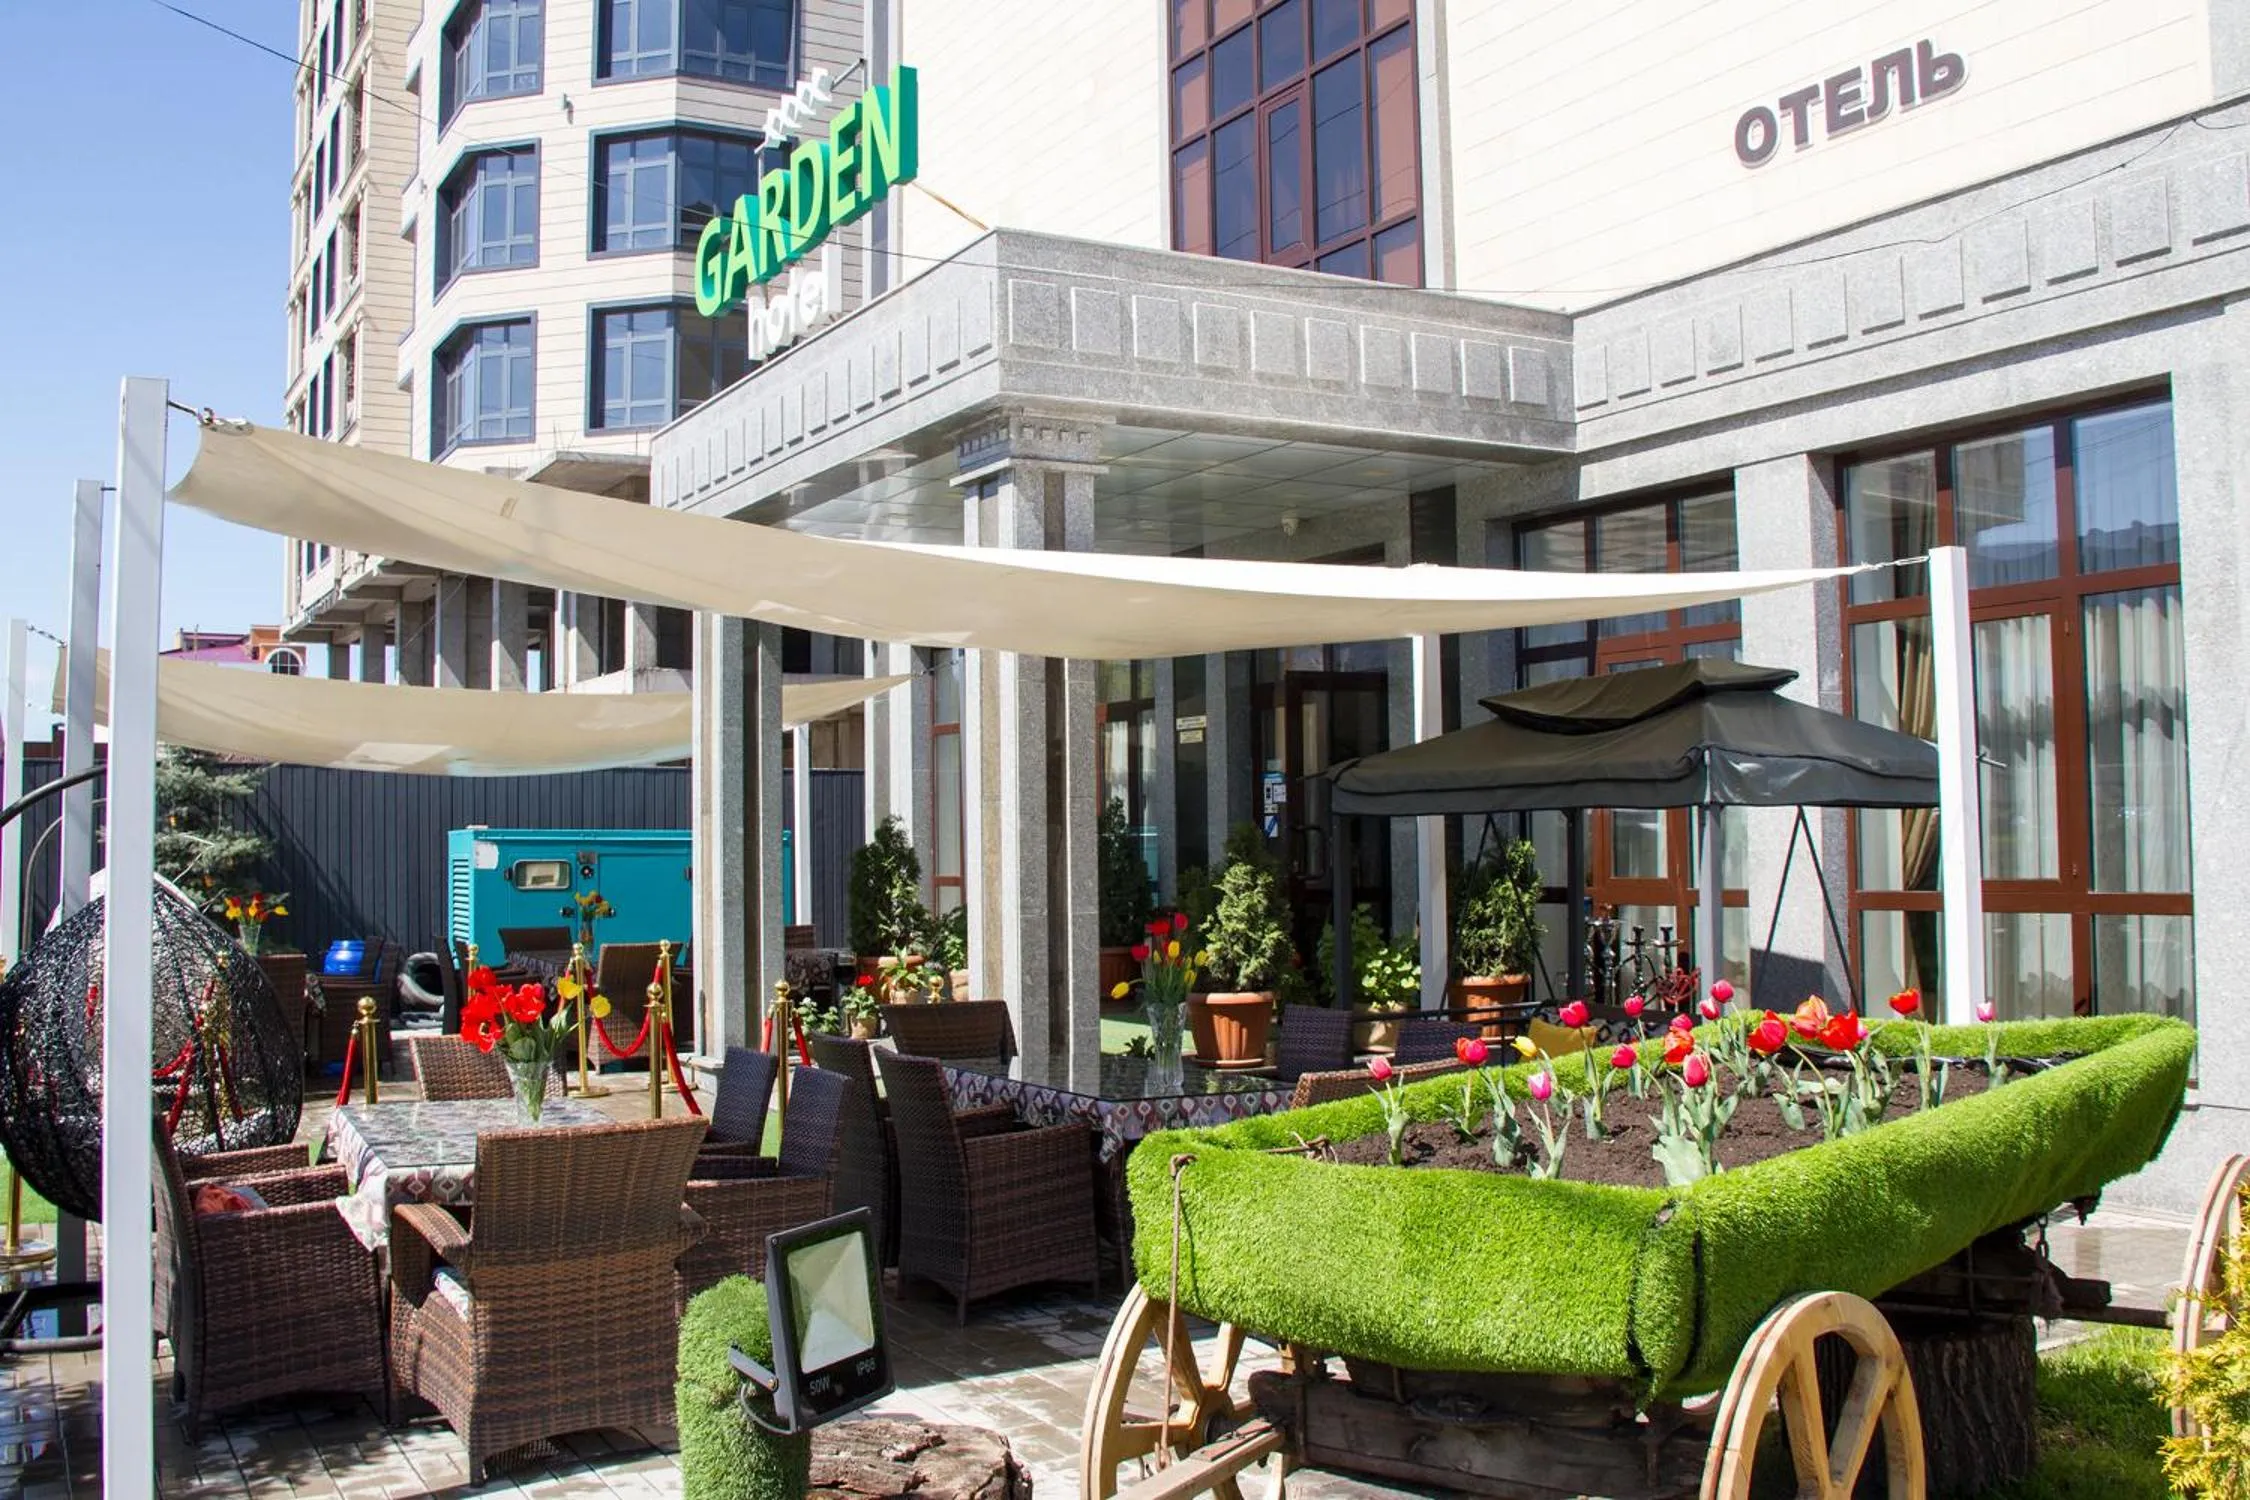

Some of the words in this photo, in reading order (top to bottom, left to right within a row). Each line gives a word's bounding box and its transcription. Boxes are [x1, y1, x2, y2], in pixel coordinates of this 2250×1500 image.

[1735, 39, 1967, 164] ОТЕЛЬ
[694, 65, 918, 317] GARDEN
[747, 243, 842, 361] hotel
